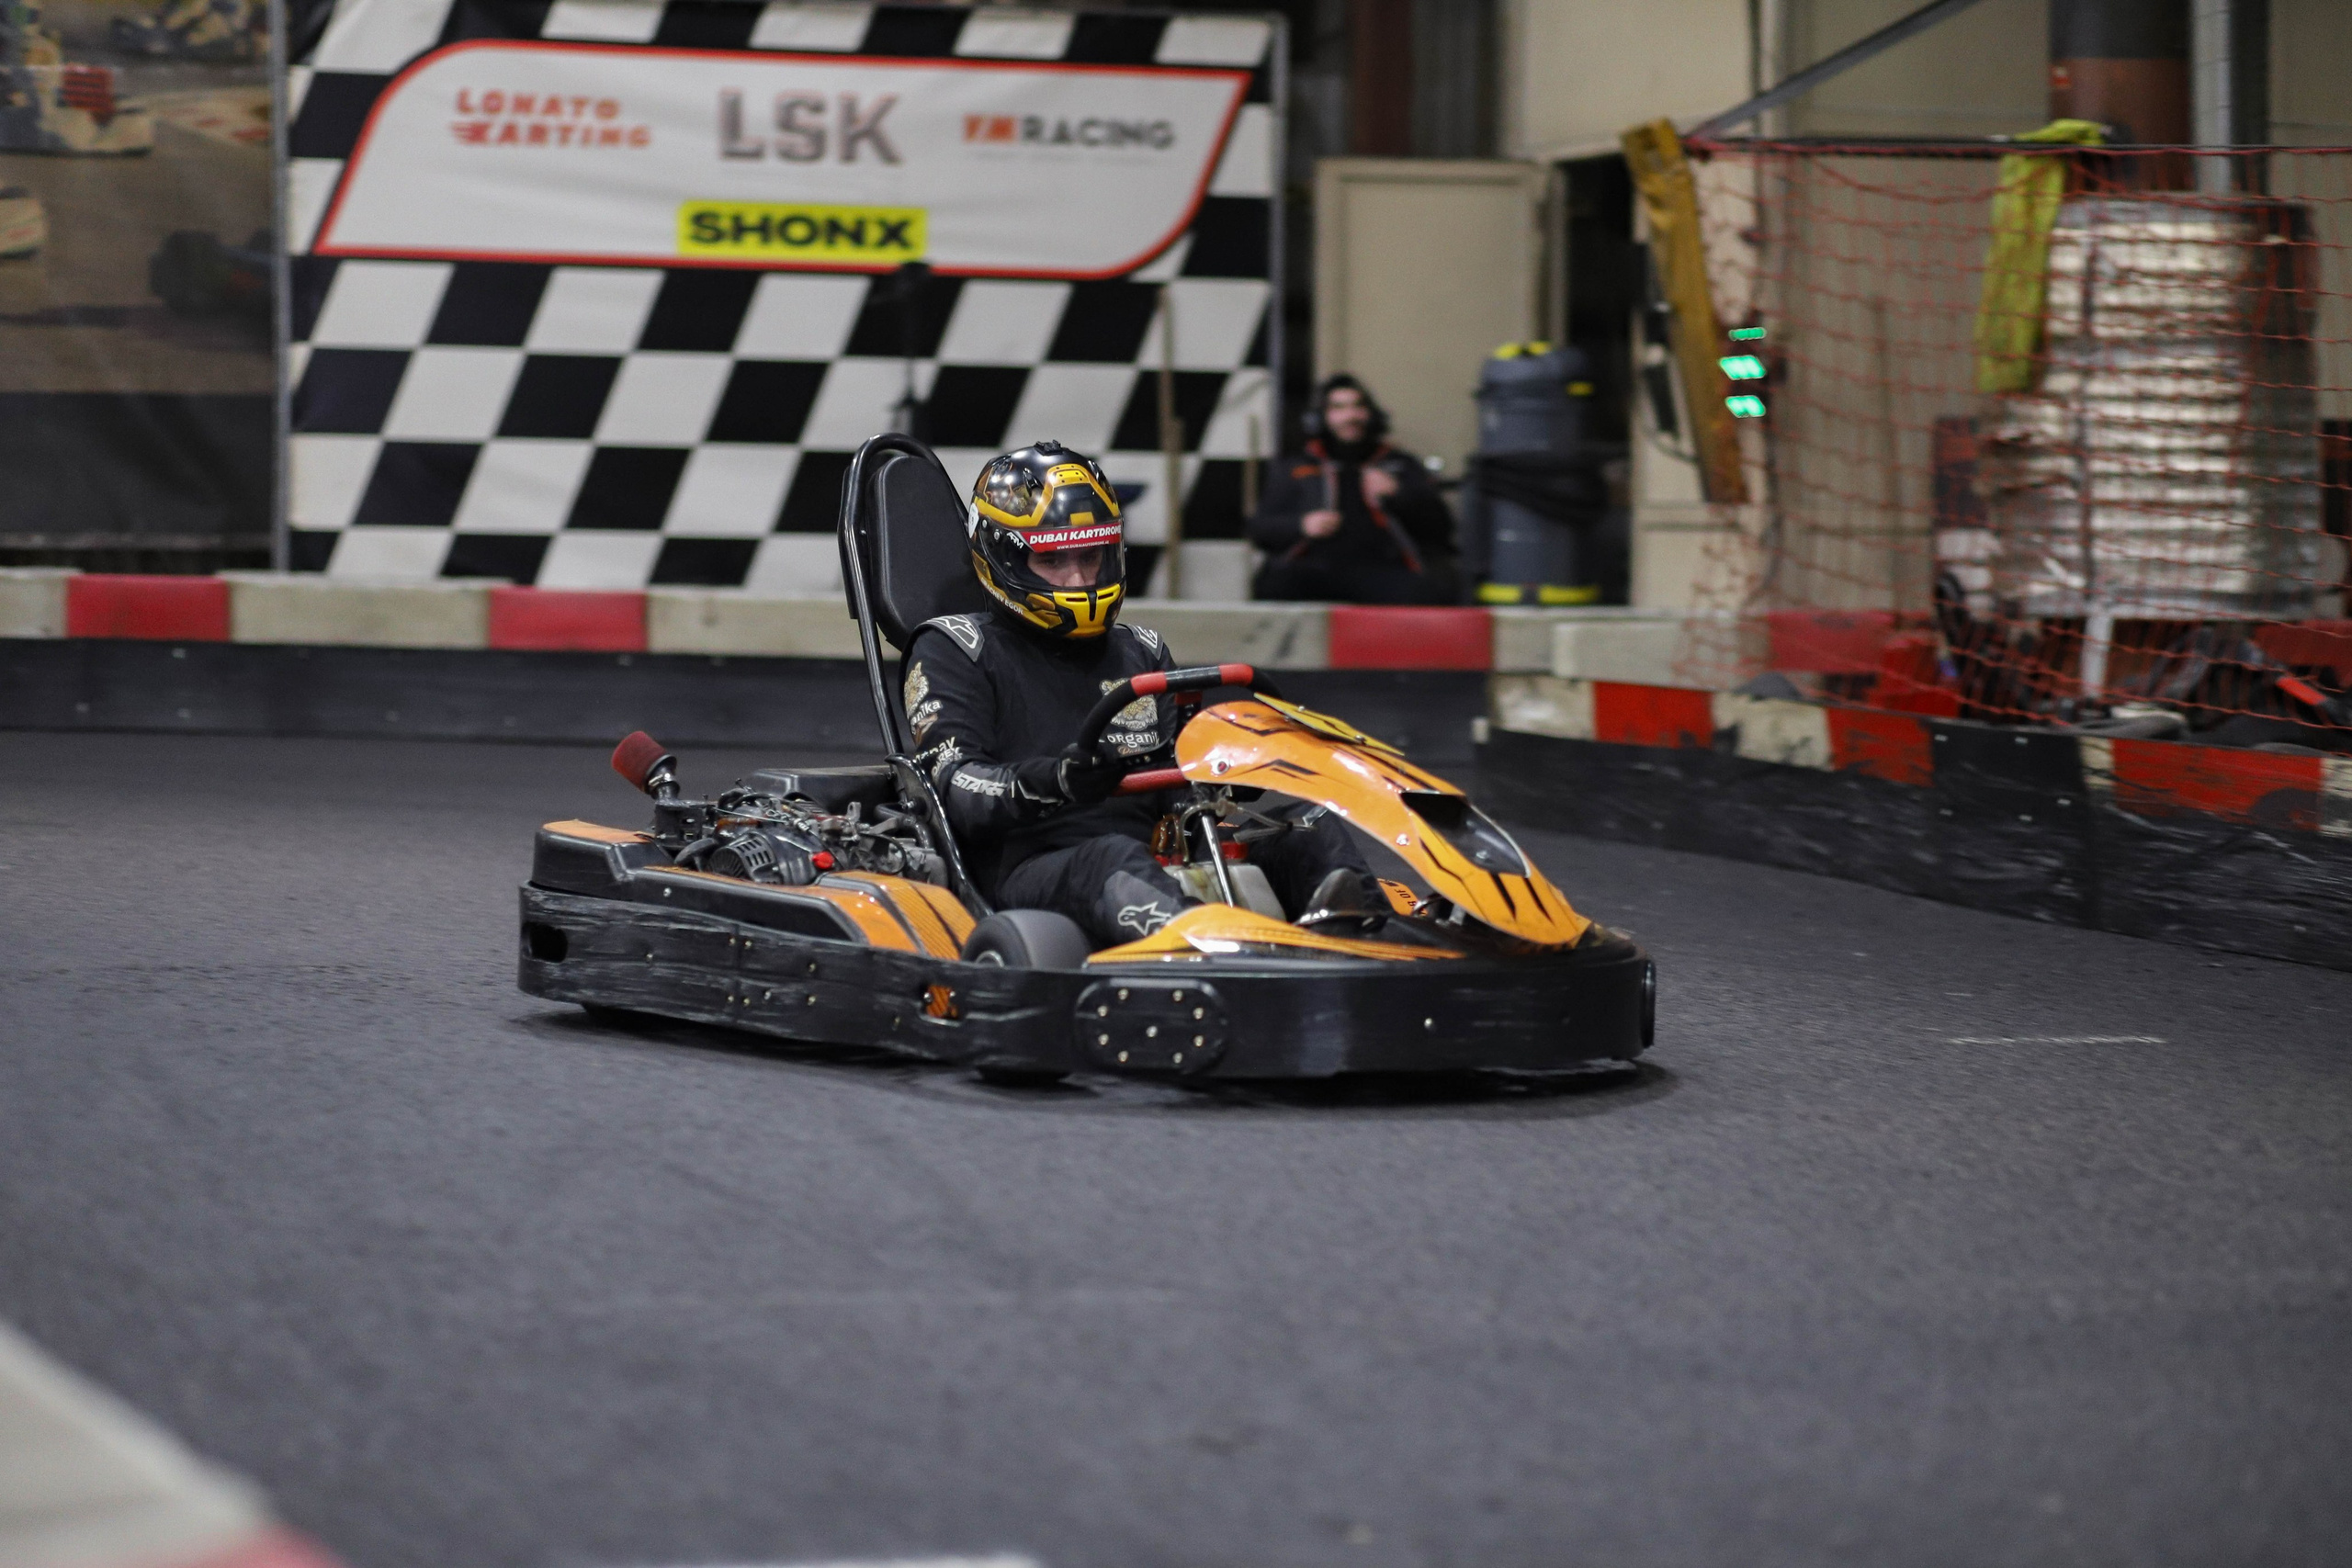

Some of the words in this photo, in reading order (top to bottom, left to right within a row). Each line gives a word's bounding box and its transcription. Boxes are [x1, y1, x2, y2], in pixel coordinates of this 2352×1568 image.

[718, 85, 904, 166] LSK
[689, 210, 915, 249] SHONX
[1029, 532, 1068, 545] DUBAI
